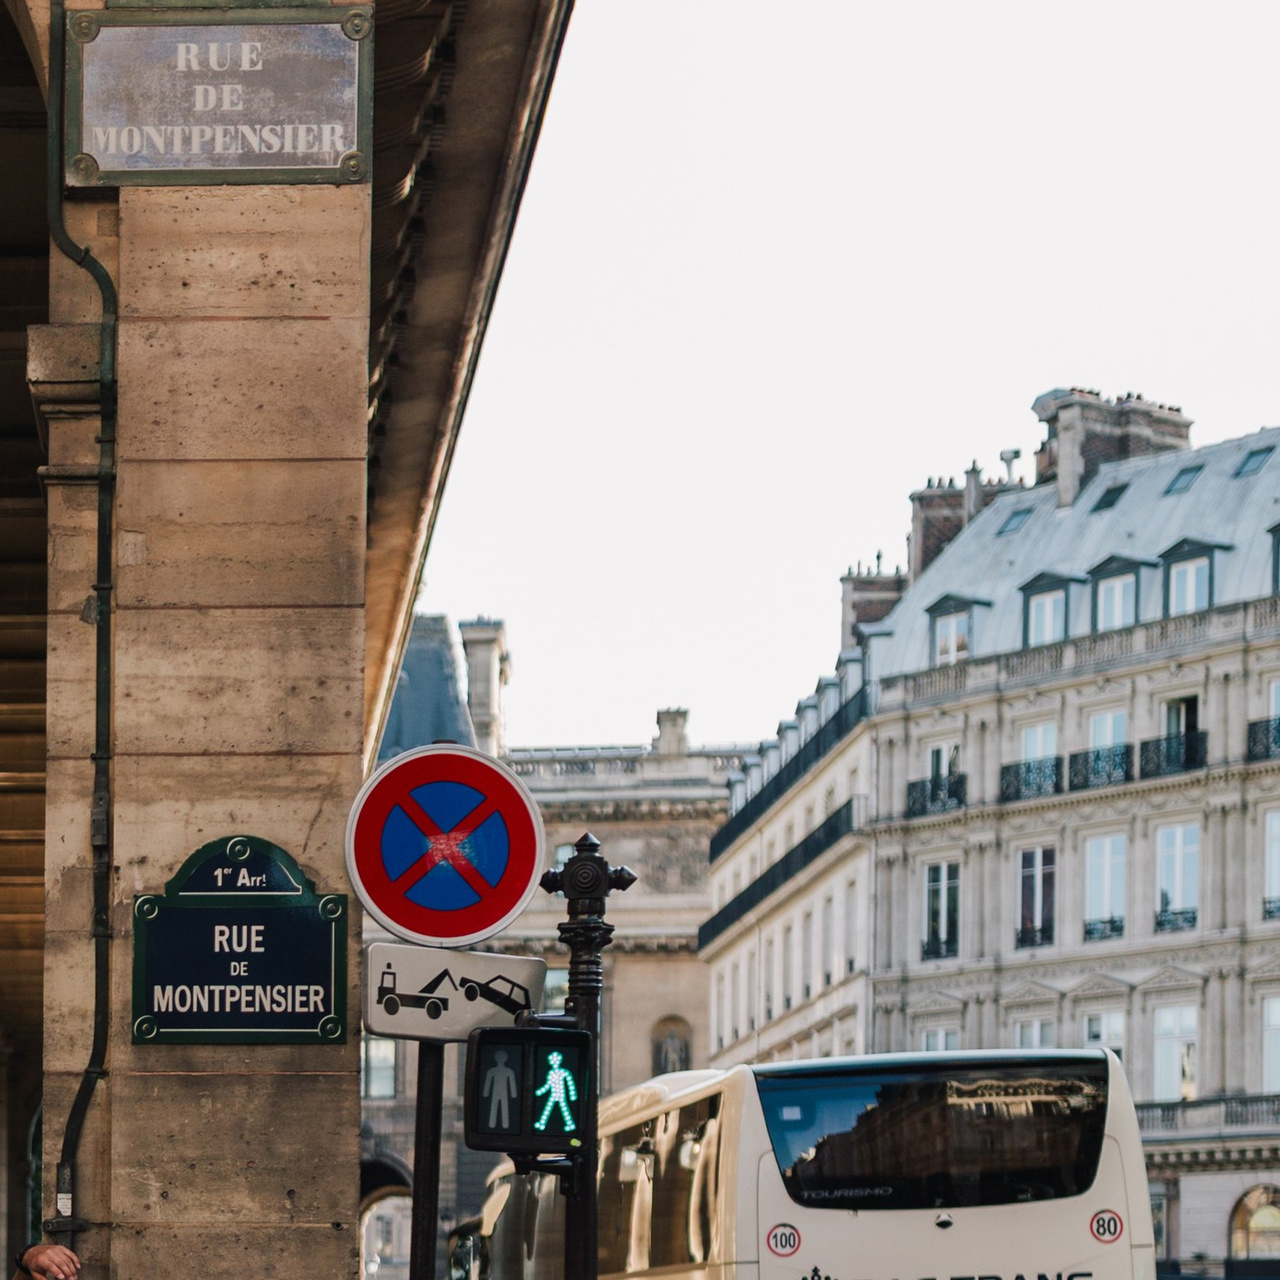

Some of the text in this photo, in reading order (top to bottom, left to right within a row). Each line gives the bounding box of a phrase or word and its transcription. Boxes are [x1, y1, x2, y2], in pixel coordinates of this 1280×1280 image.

[175, 42, 263, 72] RUE
[193, 84, 244, 112] DE
[91, 124, 346, 155] MONTPENSIER
[213, 925, 265, 953] RUE
[230, 961, 249, 976] DE
[153, 984, 325, 1013] MONTPENSIER
[802, 1186, 893, 1200] TOURISMO
[771, 1231, 796, 1250] 100
[1096, 1217, 1118, 1237] 80
